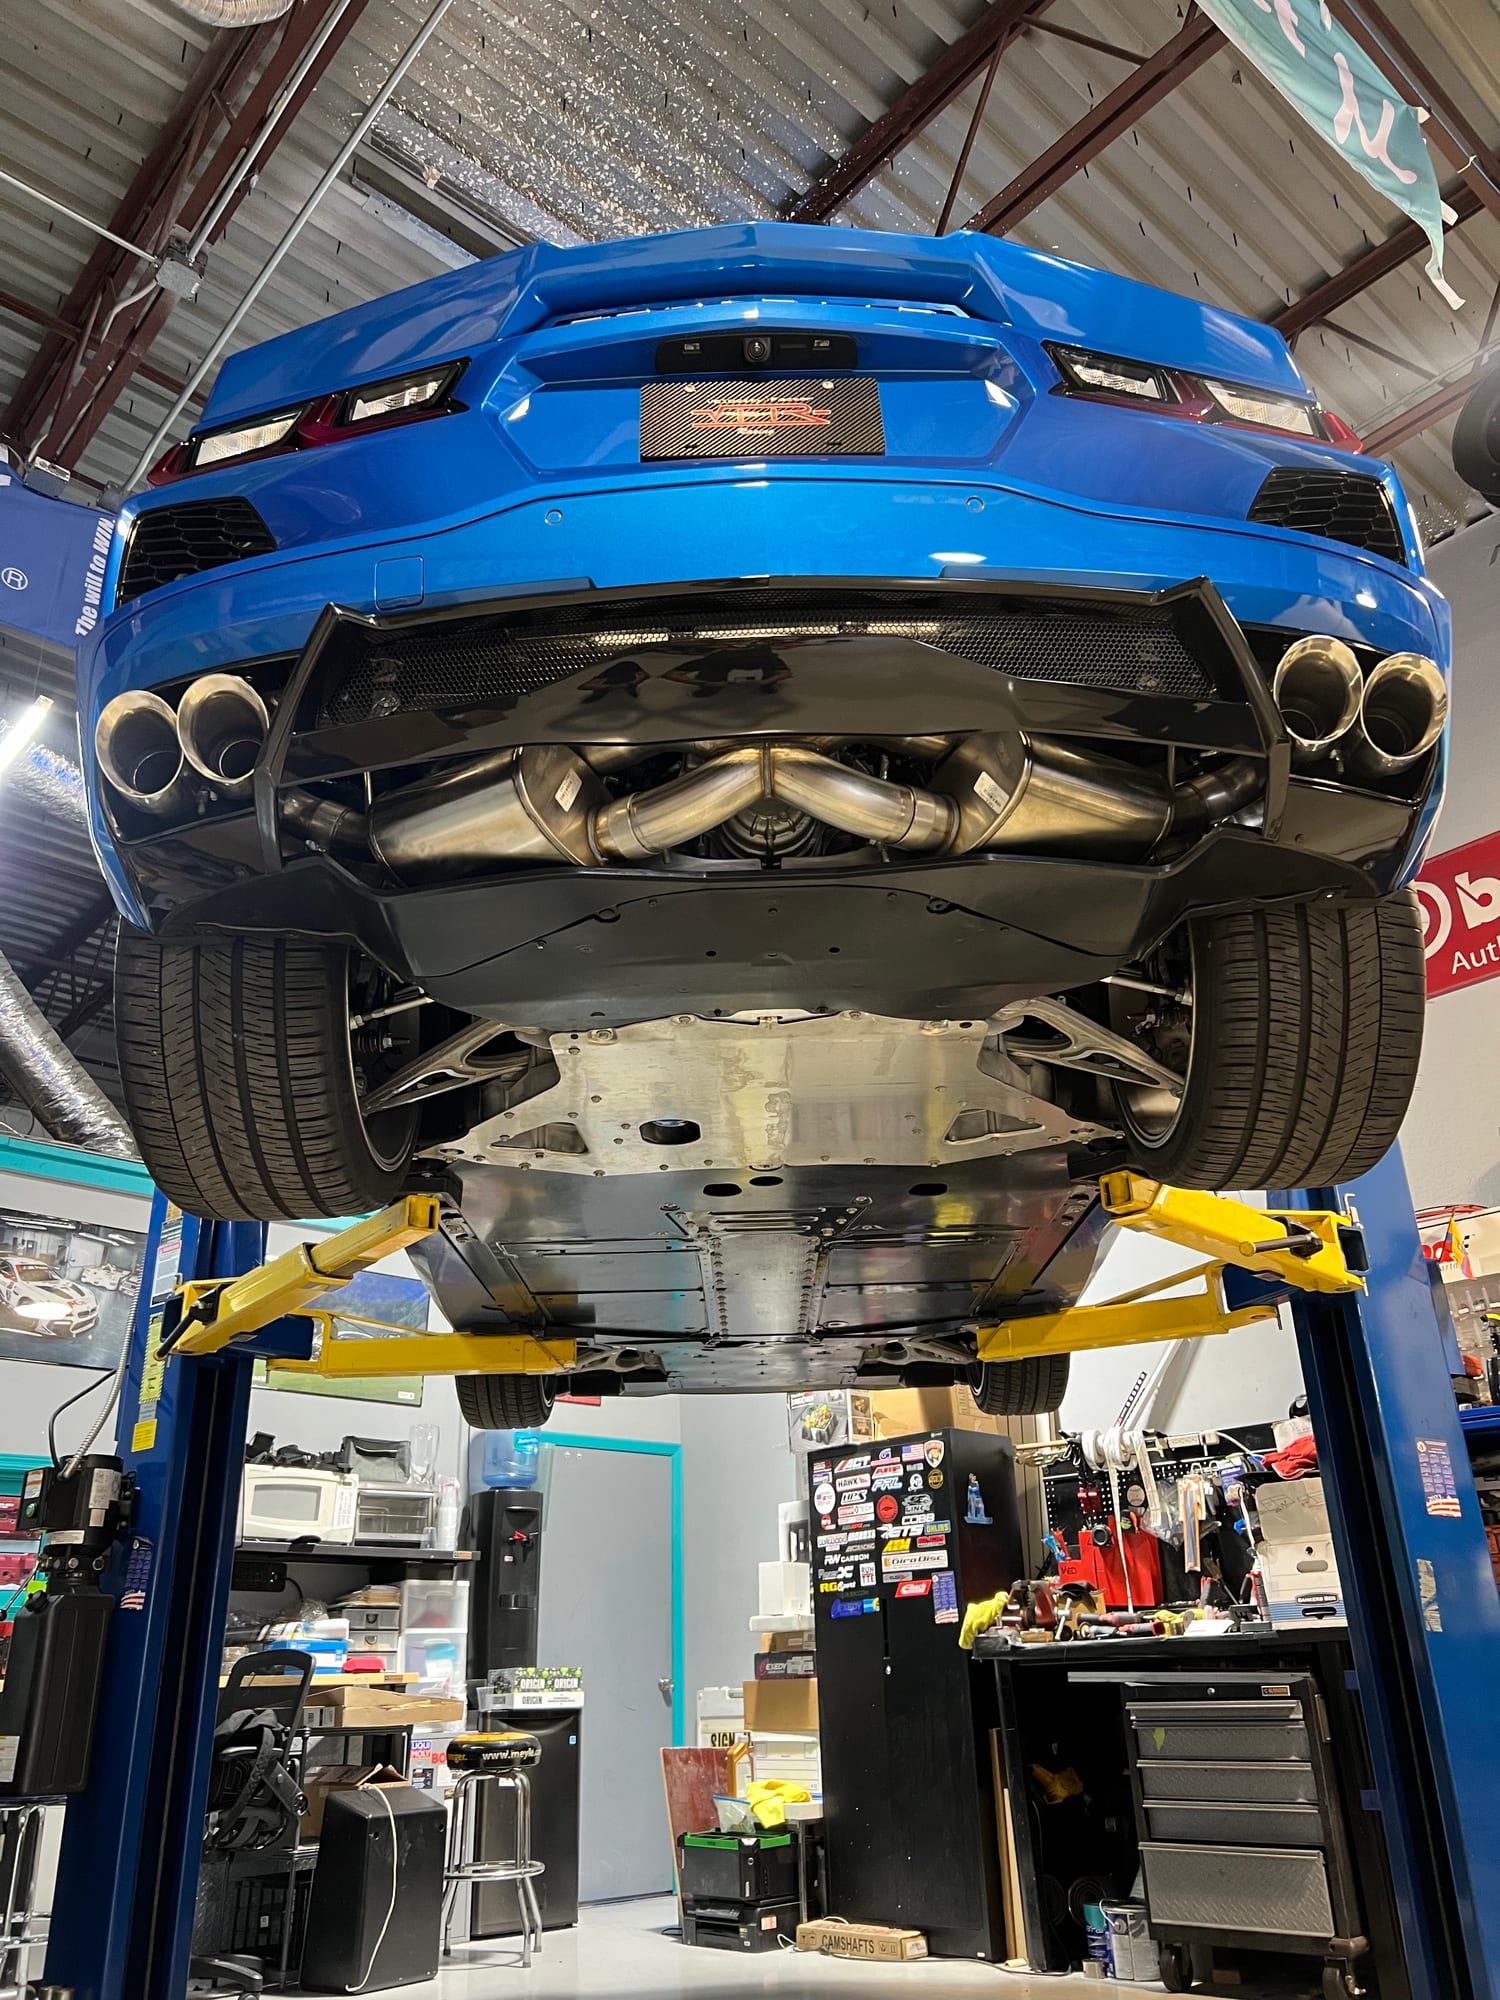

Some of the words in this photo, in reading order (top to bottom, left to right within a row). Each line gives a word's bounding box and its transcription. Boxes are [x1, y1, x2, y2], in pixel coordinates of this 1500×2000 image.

[92, 516, 117, 556] WIN.
[90, 554, 107, 575] to
[84, 571, 103, 606] will
[75, 604, 99, 637] The
[1451, 934, 1500, 975] Aut
[837, 1477, 859, 1489] HAWK
[842, 1491, 867, 1502] HPS
[823, 1553, 842, 1566] RW
[841, 1553, 870, 1563] CARBON
[819, 1582, 839, 1593] RG
[520, 1678, 545, 1690] ORIGIN
[553, 1677, 579, 1689] ORIGIN
[521, 1695, 543, 1705] ORIGIN
[821, 1934, 875, 1954] CAMSHAFTS
